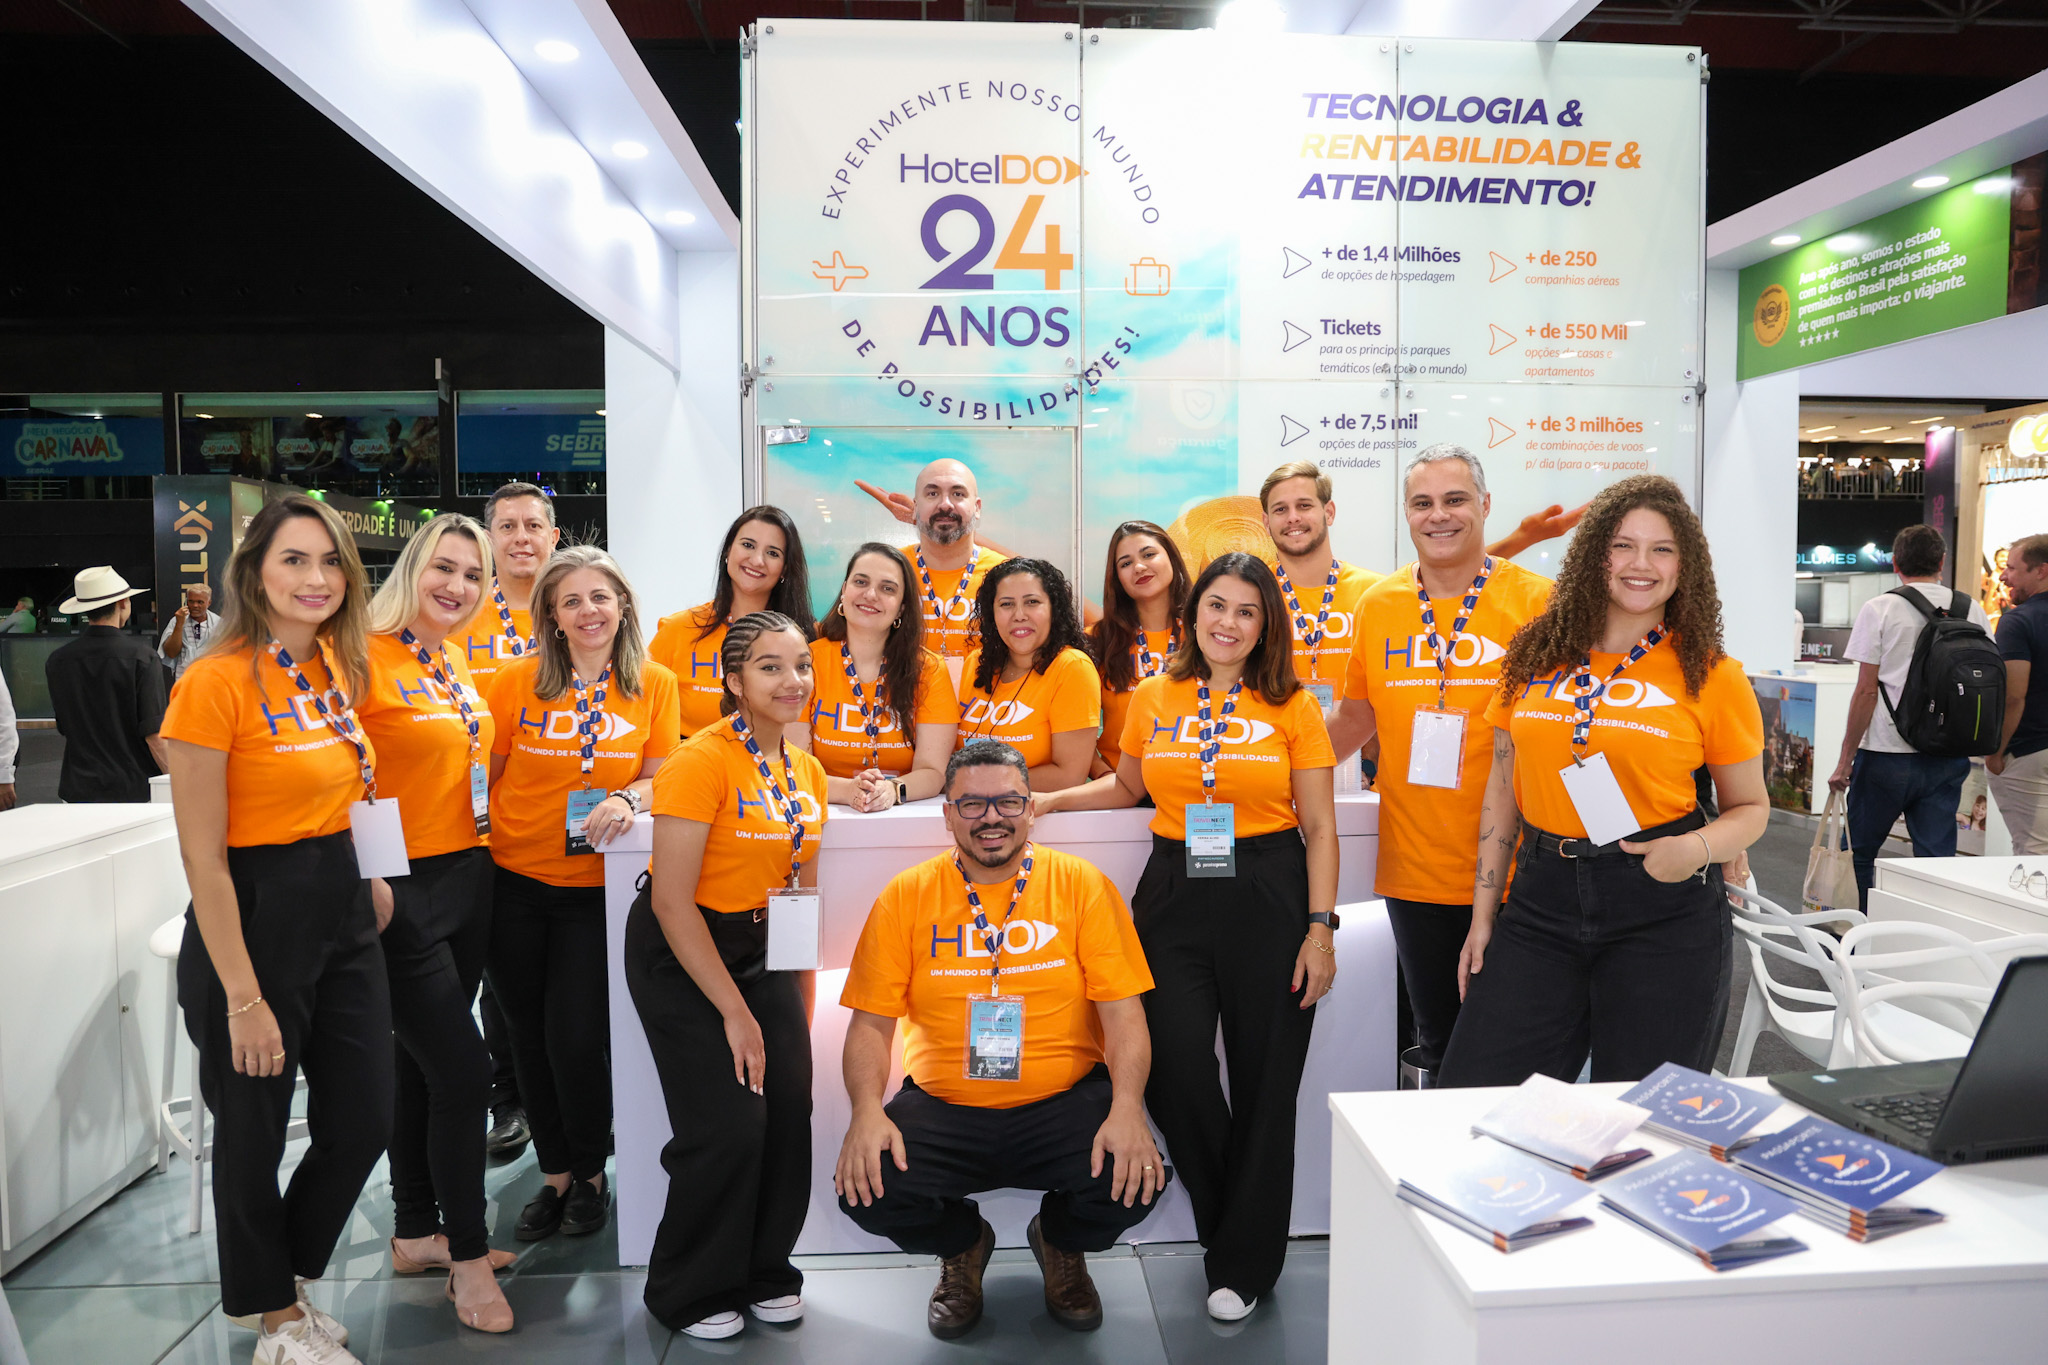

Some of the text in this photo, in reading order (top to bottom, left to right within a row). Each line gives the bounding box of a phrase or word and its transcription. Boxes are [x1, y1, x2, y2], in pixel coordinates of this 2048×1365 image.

[1302, 93, 1584, 127] TECNOLOGIA &
[822, 80, 1160, 224] EXPERIMENTE NOSSO MUNDO
[1300, 134, 1642, 169] RENTABILIDADE &
[1298, 173, 1596, 207] ATENDIMENTO!
[918, 194, 1074, 290] 24
[1337, 245, 1358, 261] de
[1363, 245, 1388, 263] 1,4
[1393, 246, 1461, 263] Milhões
[1540, 250, 1561, 266] de
[1565, 250, 1597, 266] 250
[1799, 226, 1941, 285] Ano após ano, somos o estado
[1321, 269, 1455, 283] de opções de hospedagem
[1798, 287, 1817, 300] com
[1818, 283, 1829, 294] os
[1830, 268, 1869, 290] destinos
[1870, 267, 1877, 277] e
[1879, 252, 1921, 275] atrações
[1923, 240, 1951, 260] mais
[1525, 275, 1620, 287] companhias aéreas
[1798, 293, 1843, 319] premiados
[1844, 289, 1857, 301] do
[1859, 277, 1886, 297] Brasil
[1888, 271, 1909, 292] pela
[1911, 254, 1967, 282] satisfação
[1798, 320, 1809, 333] de
[1810, 313, 1835, 332] quem
[1836, 305, 1858, 322] mais
[1860, 293, 1902, 316] importa:
[1903, 290, 1911, 303] o
[1914, 274, 1967, 300] viajante.
[918, 306, 1071, 347] ANOS
[1320, 319, 1382, 335] Tickets
[1540, 323, 1561, 339] de
[1565, 323, 1597, 339] 550
[1601, 324, 1628, 340] Mil
[1319, 345, 1343, 356] para
[1345, 346, 1357, 354] os
[1410, 346, 1451, 357] parques
[1525, 347, 1560, 359] opções
[1577, 349, 1604, 358] casas
[842, 319, 1141, 421] DE POSSIBILIDADES!
[1320, 362, 1370, 373] temáticos
[1420, 365, 1426, 373] o
[1428, 363, 1467, 375] mundo)
[1525, 366, 1595, 378] apartamentos
[1335, 413, 1356, 430] de
[1361, 414, 1387, 432] 7,5
[1391, 413, 1418, 430] mil
[1541, 416, 1561, 432] de
[1565, 416, 1575, 432] 3
[1580, 416, 1644, 433] milhões
[19, 434, 119, 462] CARNAVAL
[1319, 438, 1417, 451] opções de passeios
[1526, 440, 1644, 453] de combinações de voos
[1319, 457, 1381, 468] e atividades
[1539, 458, 1555, 470] dia
[1557, 459, 1582, 471] (para
[1584, 461, 1591, 469] o
[1612, 459, 1649, 471] pacote)
[388, 511, 395, 537] É
[1395, 678, 1423, 686] MUNDO
[1525, 711, 1563, 722] MUNDO
[1590, 718, 1669, 739] OSSIBILIDADES!
[275, 745, 292, 753] UM
[294, 740, 325, 752] MUNDO
[526, 746, 555, 756] MUNDO
[821, 738, 849, 748] MUNDO
[1154, 751, 1187, 759] MUNDO
[1218, 753, 1280, 763] SSIBILIDADES!
[736, 830, 752, 839] UM
[754, 832, 783, 840] MUNDO
[1000, 958, 1066, 975] OSSIBILIDADES!
